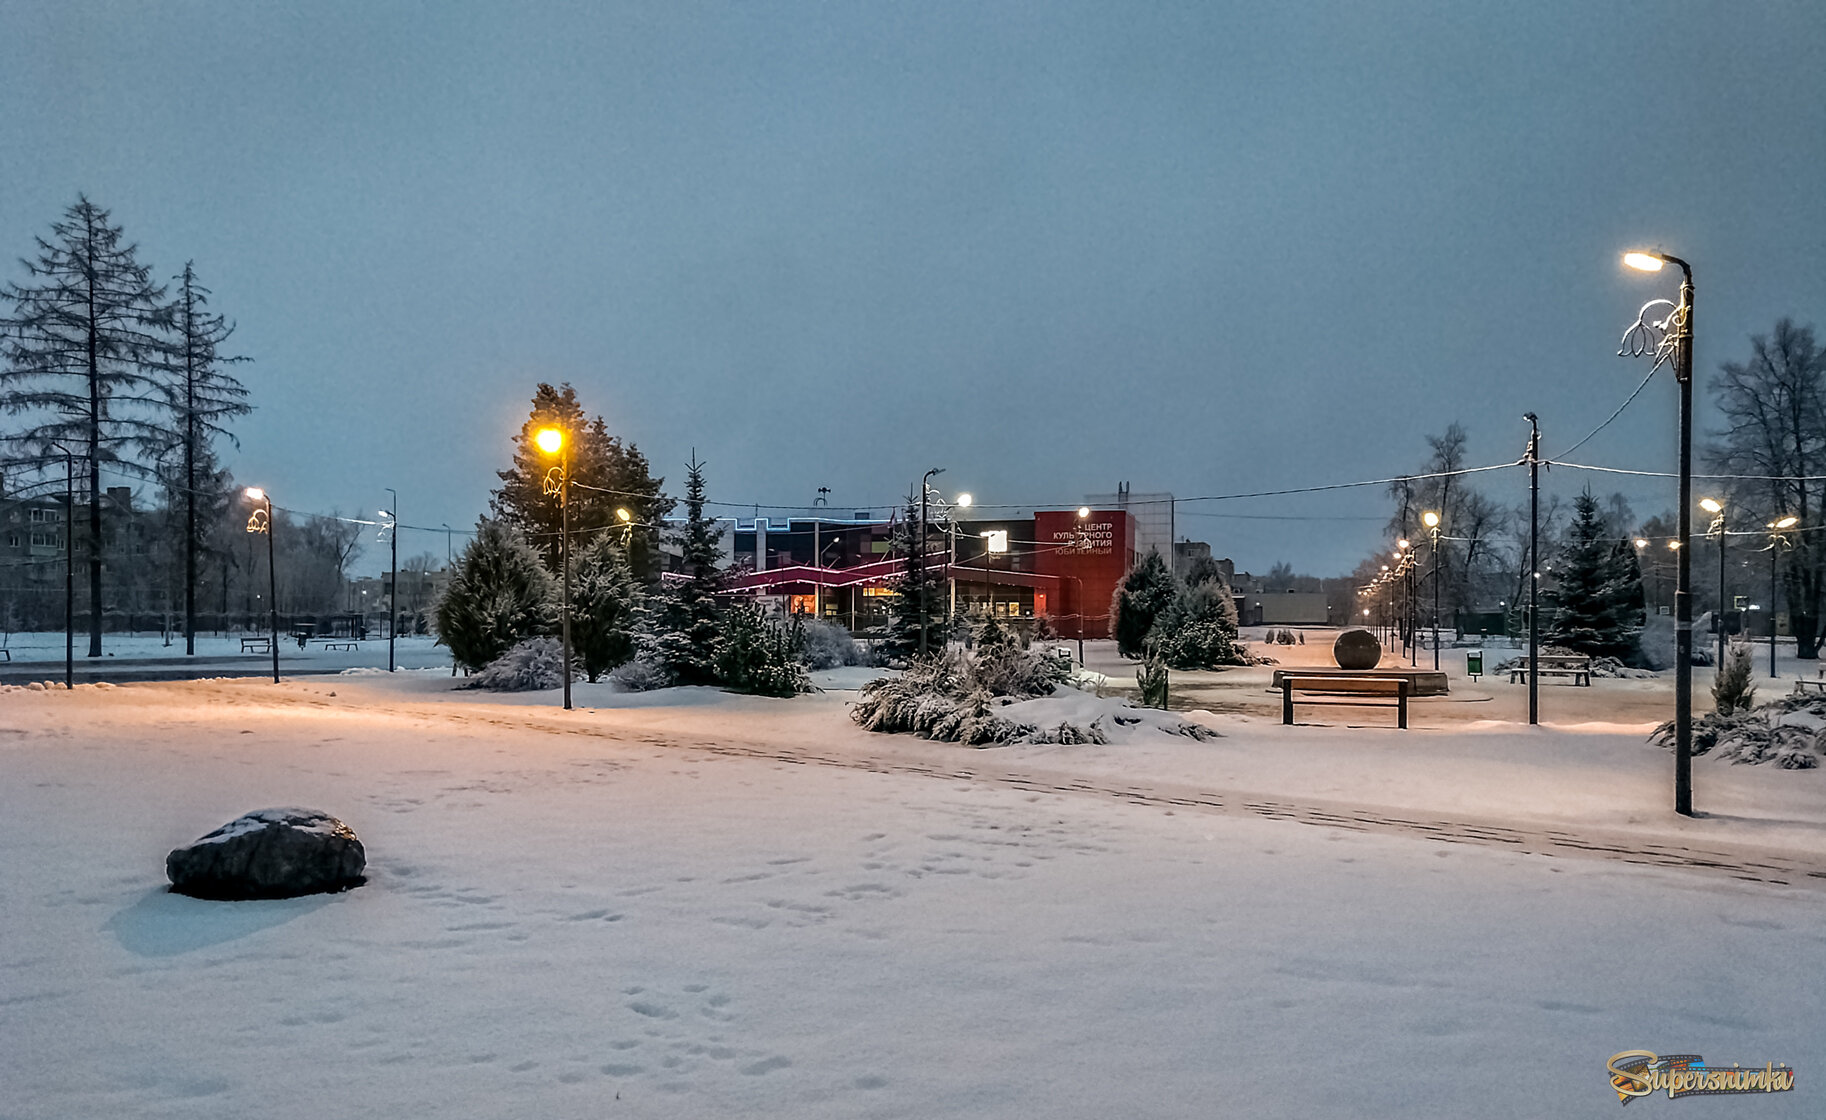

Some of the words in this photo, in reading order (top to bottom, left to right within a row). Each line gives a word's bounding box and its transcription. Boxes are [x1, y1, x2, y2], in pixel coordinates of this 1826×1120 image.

[1084, 523, 1113, 531] ЦЕНТР
[1053, 531, 1113, 540] КУЛЬРНОГО
[1068, 539, 1113, 547] РЗИТИЯ
